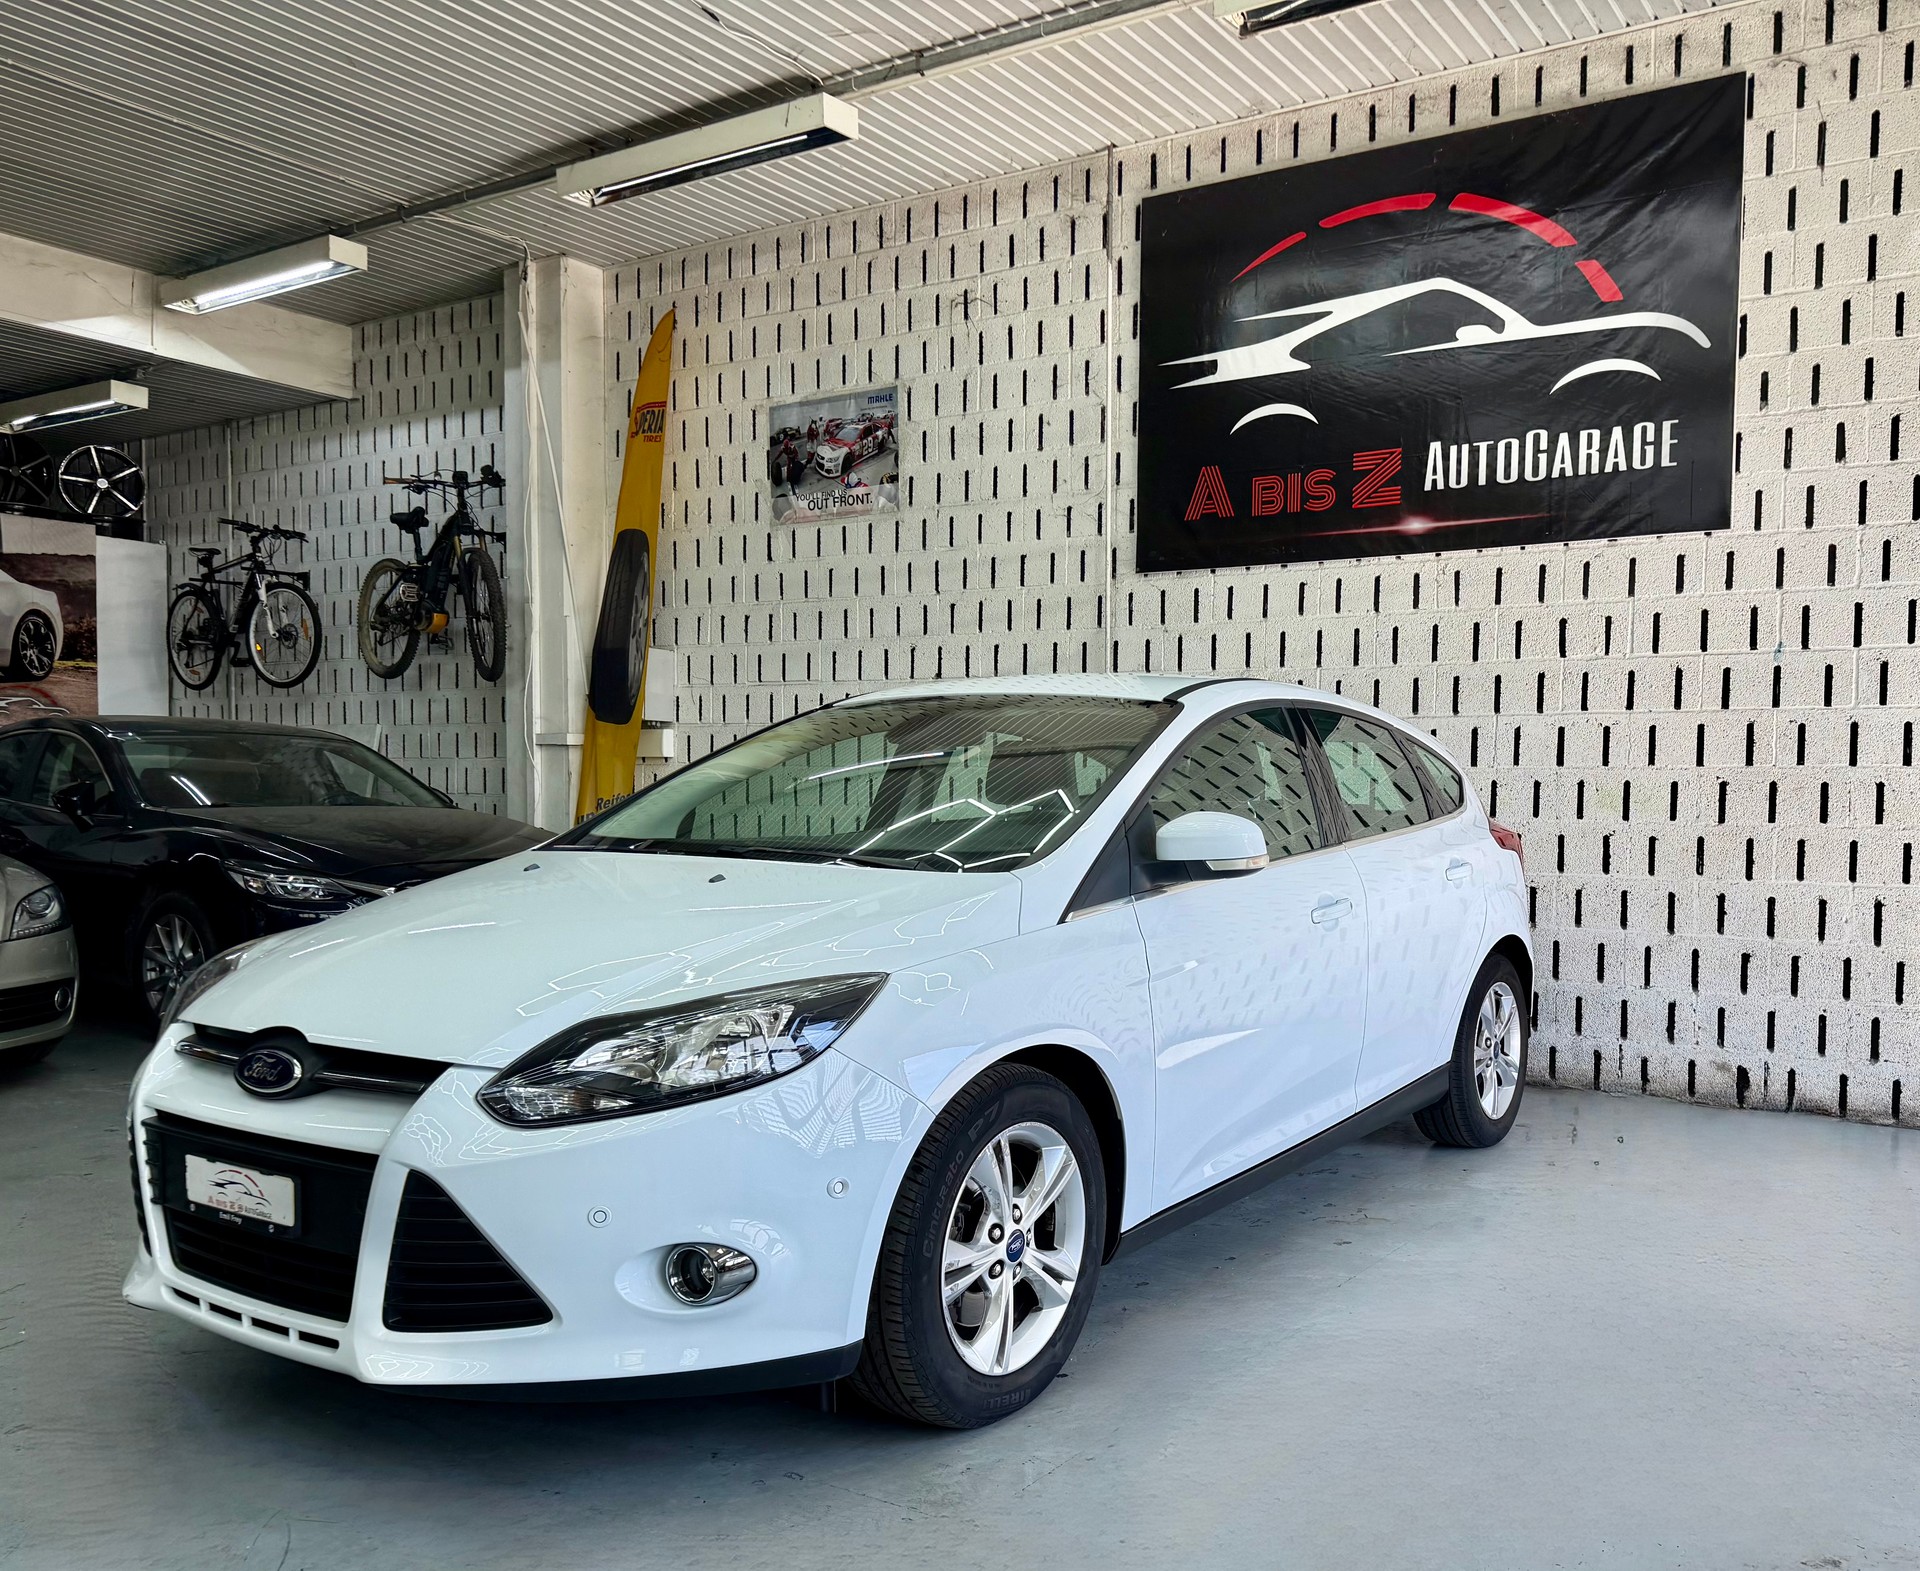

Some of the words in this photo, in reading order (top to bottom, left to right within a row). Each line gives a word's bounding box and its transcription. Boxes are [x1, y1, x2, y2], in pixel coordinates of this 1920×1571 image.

[868, 393, 893, 404] MAHLE
[862, 437, 874, 456] 29
[822, 490, 835, 498] FIND
[838, 489, 847, 497] US
[1184, 465, 1235, 521] A
[1252, 468, 1337, 517] BIS
[1352, 447, 1402, 509] Z
[808, 498, 829, 511] OUT
[833, 492, 873, 508] FRONT.
[244, 1054, 283, 1082] Ford
[922, 1150, 965, 1258] Cinturato
[967, 1101, 1000, 1143] P7
